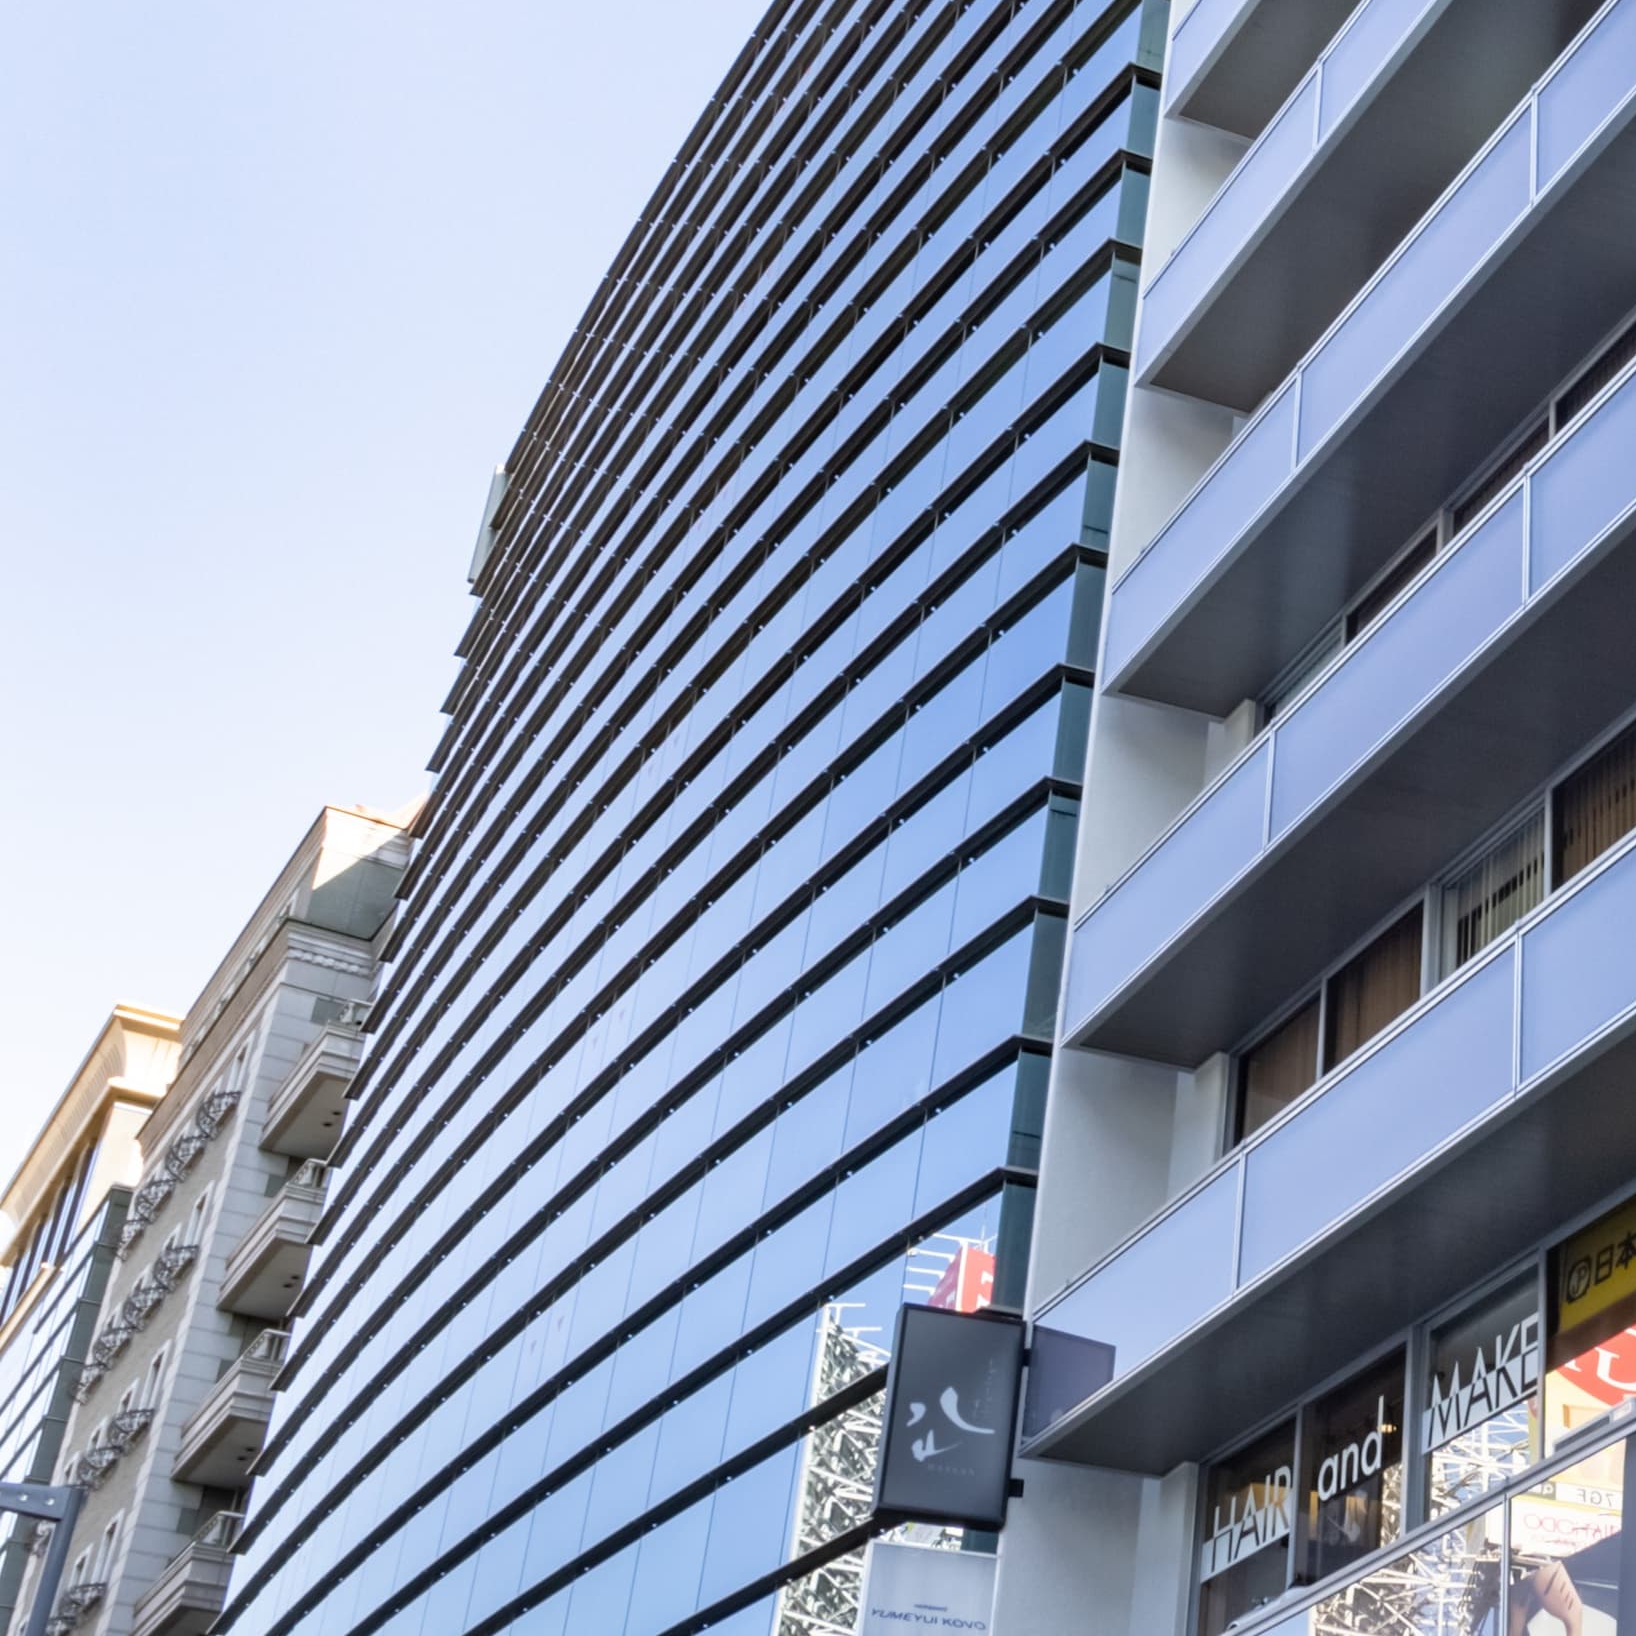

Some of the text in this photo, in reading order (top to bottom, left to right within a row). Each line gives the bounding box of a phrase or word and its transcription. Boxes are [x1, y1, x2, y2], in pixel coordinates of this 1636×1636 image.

[1209, 1464, 1293, 1573] HAIR
[1317, 1394, 1386, 1502] and
[1426, 1313, 1538, 1454] MAKE
